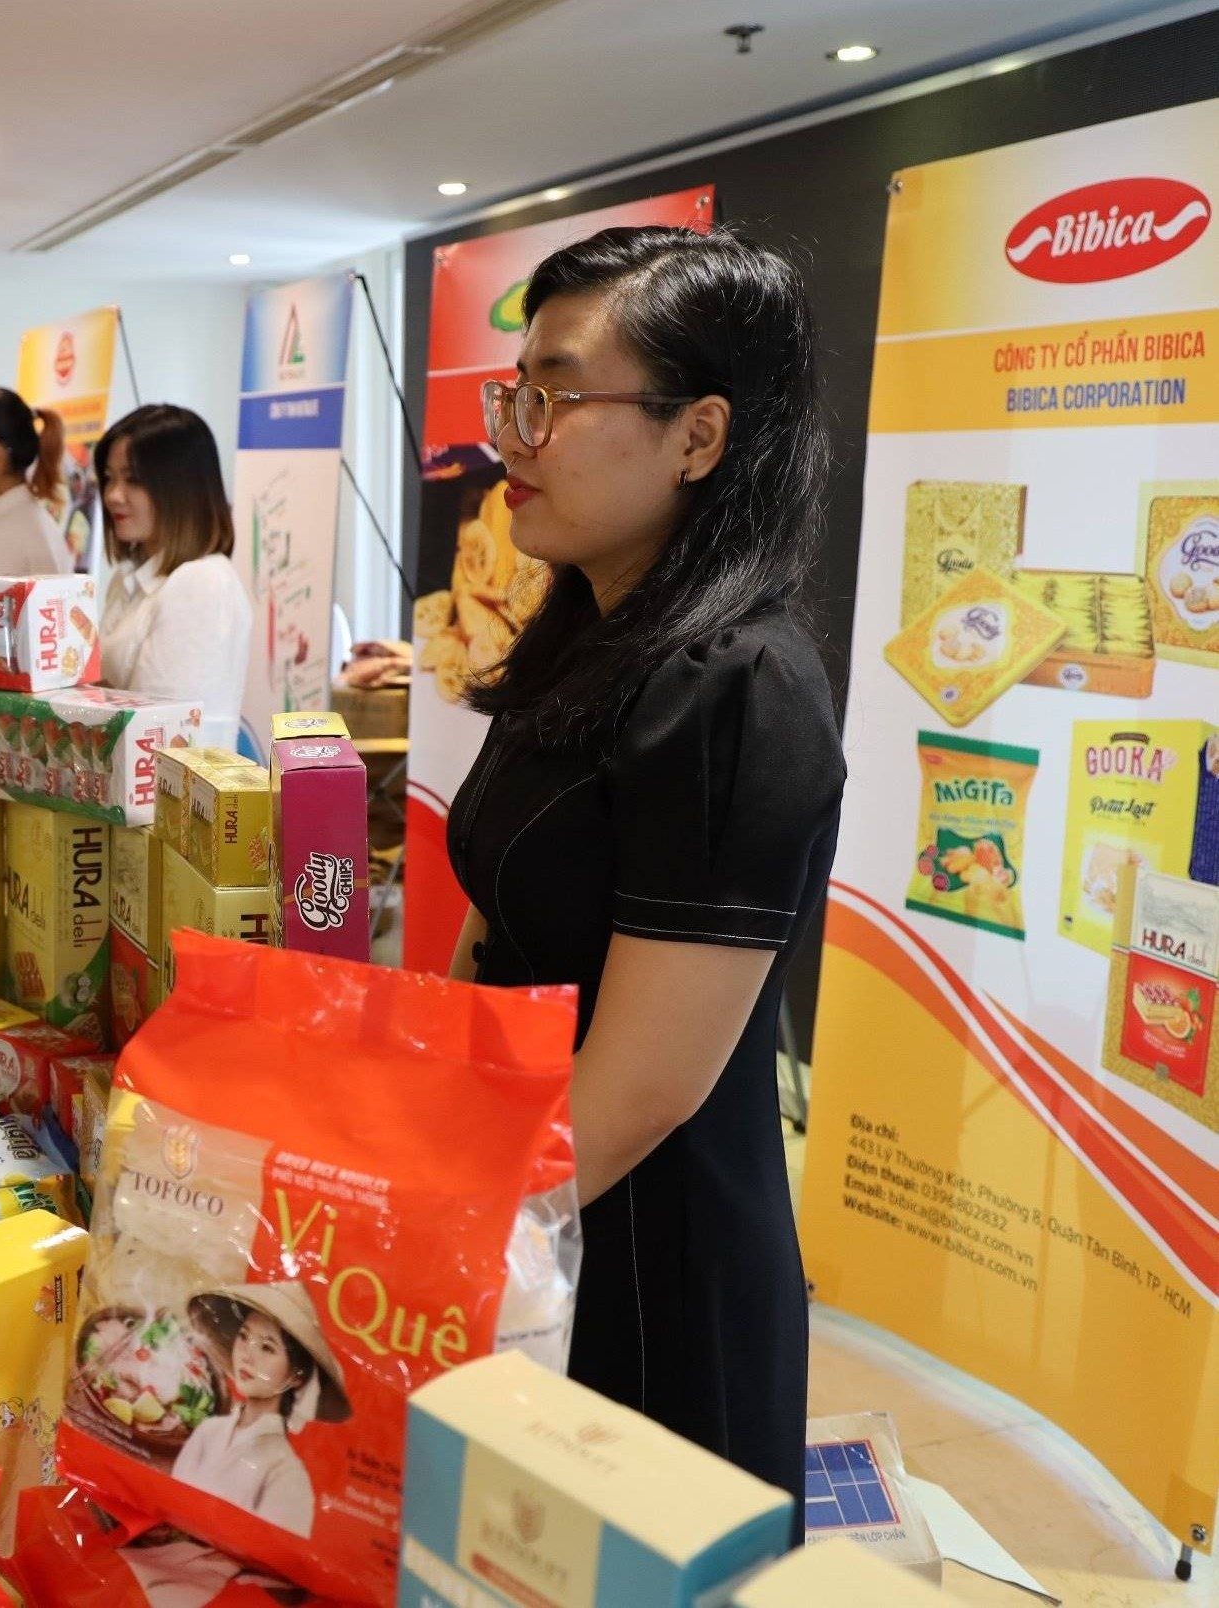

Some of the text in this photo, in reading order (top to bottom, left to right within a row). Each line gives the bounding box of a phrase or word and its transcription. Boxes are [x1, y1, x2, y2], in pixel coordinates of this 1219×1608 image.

[1051, 205, 1155, 258] Bibica
[994, 329, 1206, 373] CÔNG TY CỔ PHẦN BIBICA
[1007, 378, 1187, 412] BIBICA CORPORATION
[39, 606, 59, 672] HURA
[134, 736, 157, 806] HURA
[225, 810, 238, 844] HURA
[72, 827, 103, 949] HURA deli
[295, 851, 349, 931] Goody
[338, 858, 354, 896] CHIPS
[1142, 928, 1186, 960] HURA
[131, 1172, 224, 1217] TOFOCO
[844, 1173, 886, 1202] Email:
[843, 1194, 1038, 1292] Website: www.bibica.com.vn
[327, 1266, 469, 1369] Quê
[1163, 1287, 1192, 1319] HCM
